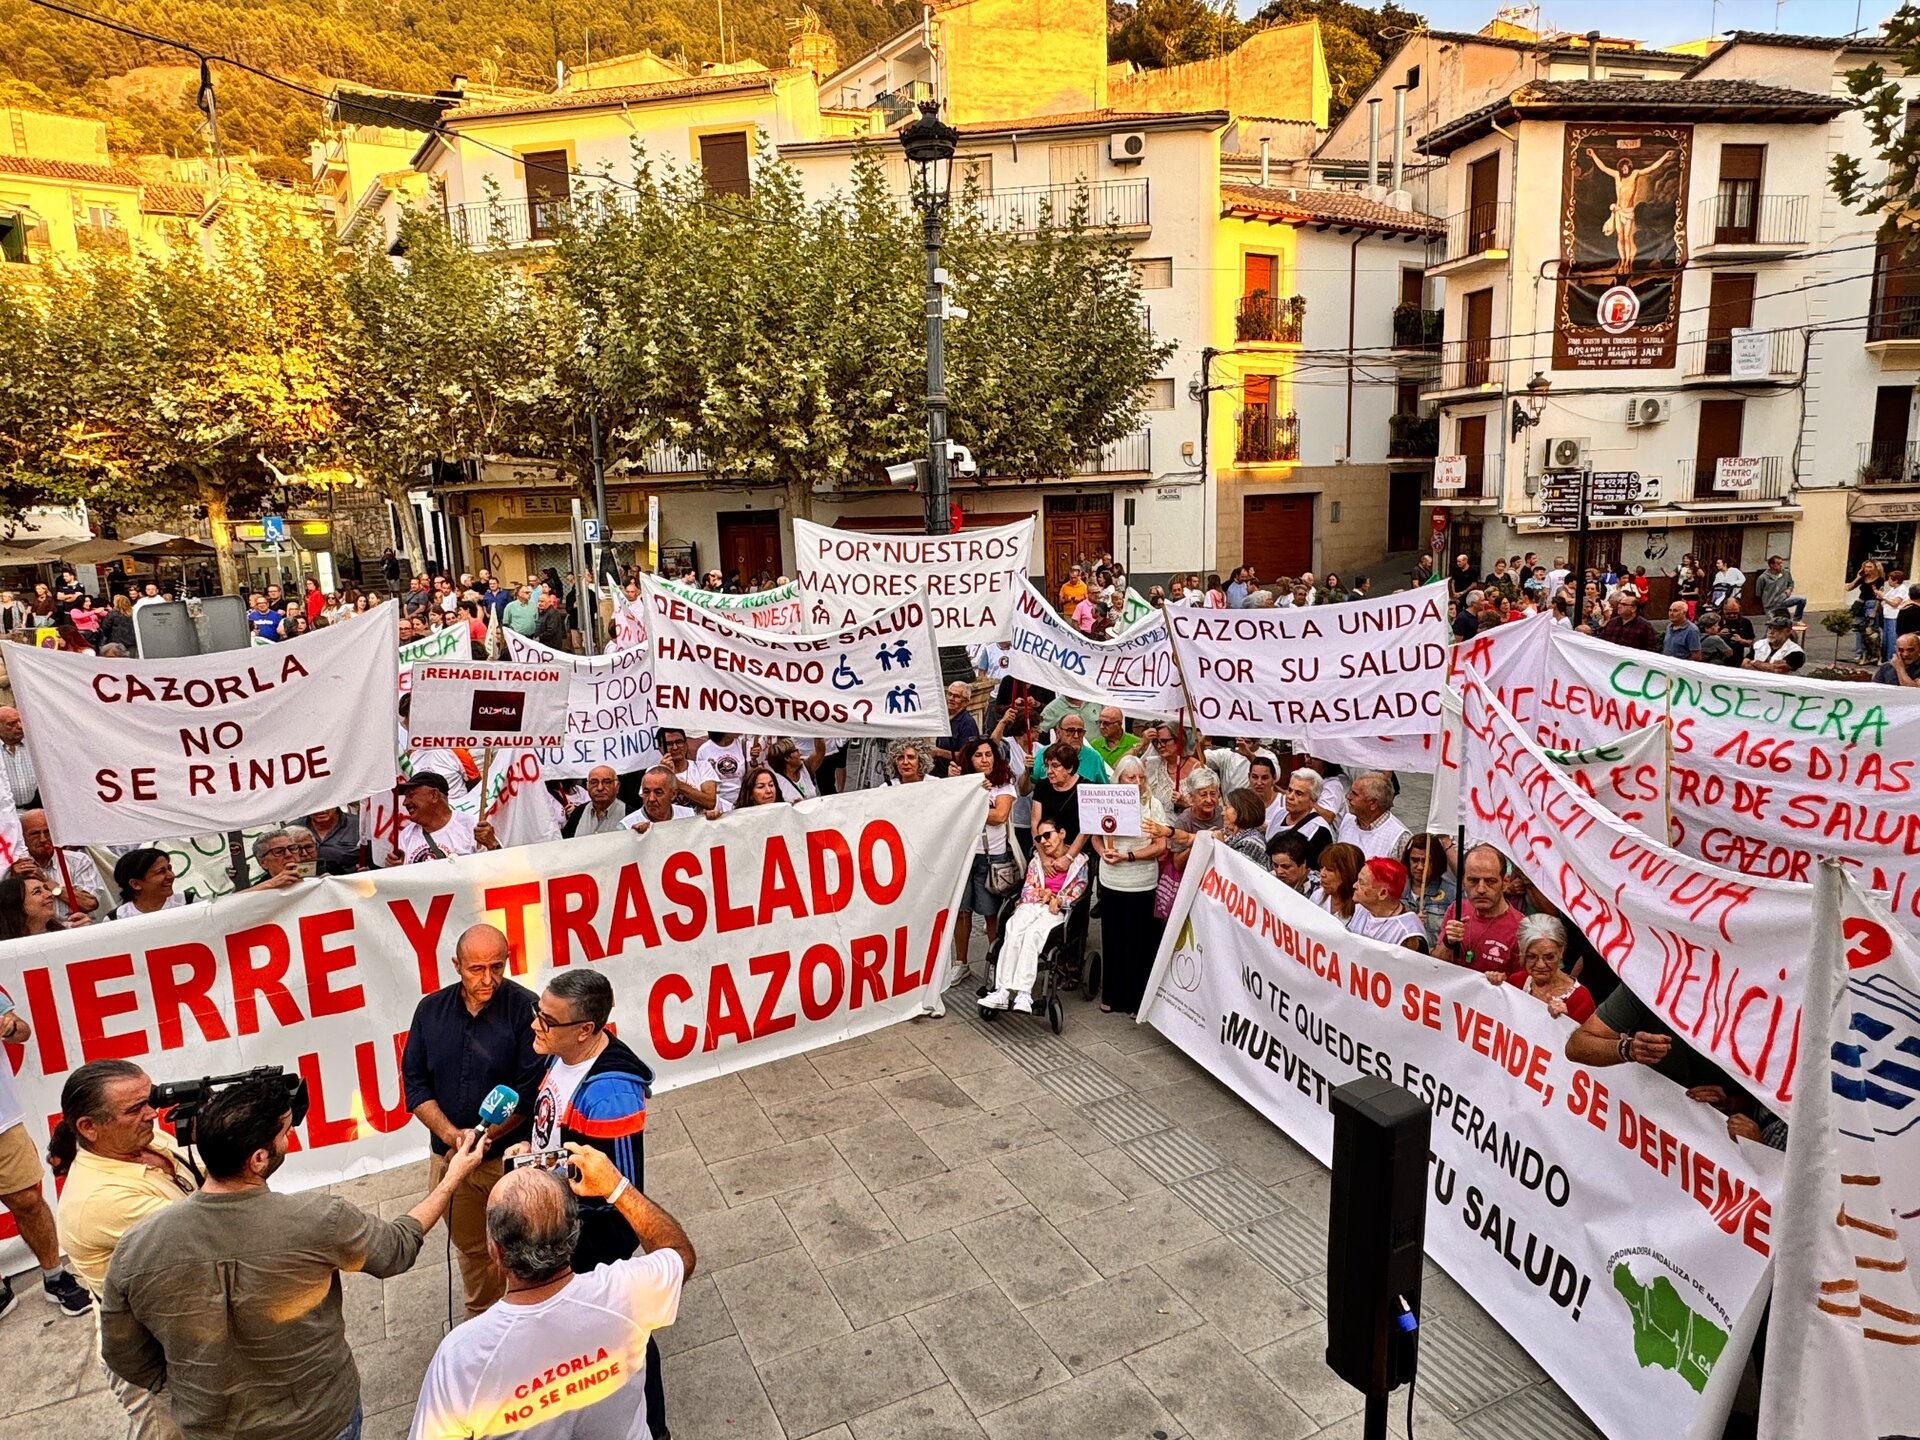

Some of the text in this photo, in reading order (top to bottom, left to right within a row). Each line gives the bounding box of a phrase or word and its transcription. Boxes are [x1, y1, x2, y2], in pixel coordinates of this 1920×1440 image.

[1596, 519, 1618, 528] Bar
[819, 536, 1019, 563] POR NUESTROS
[797, 569, 917, 596] MAYORES
[794, 638, 831, 652] DE
[838, 602, 924, 645] SALUD
[1174, 598, 1442, 641] CAZORLA UNIDA
[1012, 625, 1092, 677] UEREMOS
[1199, 656, 1254, 683] POR
[1281, 656, 1319, 683] SU
[93, 654, 309, 708] CAZORLA
[420, 667, 560, 682] ¡REHABILITACIÓN
[587, 671, 652, 705] TODO
[478, 706, 517, 716] CAZRLA
[564, 697, 659, 735] AZORLA
[656, 685, 690, 710] EN
[1228, 699, 1263, 722] AL
[1610, 660, 1889, 747] CONSEJERA
[179, 721, 243, 757] NO
[411, 735, 561, 748] CENTRO SALUD YA!
[572, 740, 596, 763] SE
[95, 745, 331, 803] SE RINDE
[1713, 730, 1795, 773] 166
[1807, 741, 1915, 793] DÍAS
[1731, 780, 1773, 820] DE
[484, 818, 908, 978] TRASLADO
[387, 893, 456, 995] Y
[1261, 906, 1343, 989] PUBLICA
[1351, 961, 1392, 1009] NO
[1402, 983, 1442, 1031] SE
[1453, 1001, 1556, 1108] VENDE,
[1567, 1070, 1610, 1133] SE
[1241, 961, 1263, 1001] NO
[1268, 981, 1290, 1024] TE
[1294, 1003, 1393, 1082] QUEDES
[1403, 1062, 1571, 1208] ESPERANDO
[1462, 1185, 1592, 1323] SALUD!
[1652, 1249, 1691, 1283] ANDALUZA
[1692, 1278, 1706, 1295] DE
[504, 1361, 621, 1425] NO SE RINDE
[514, 1346, 609, 1400] CAZORLA
